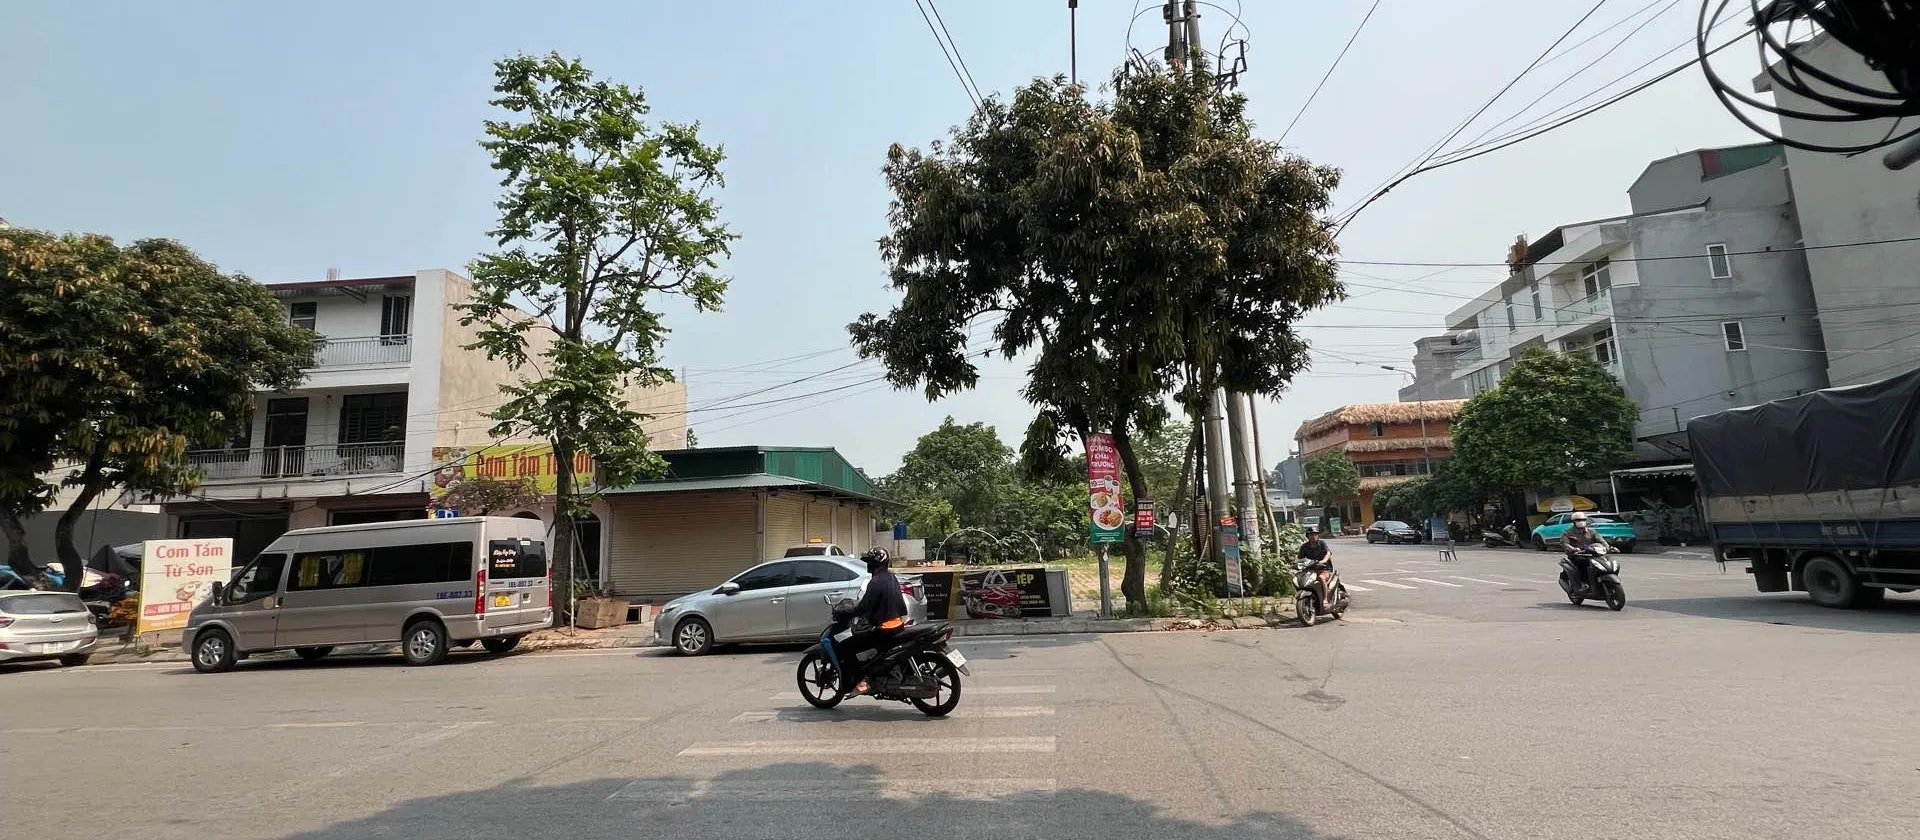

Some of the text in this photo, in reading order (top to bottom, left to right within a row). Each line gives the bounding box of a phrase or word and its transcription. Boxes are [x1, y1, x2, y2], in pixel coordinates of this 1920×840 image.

[1090, 445, 1113, 453] COMBO
[476, 453, 506, 477] Cơm
[156, 545, 189, 559] Cơm
[187, 562, 214, 577] Sơn
